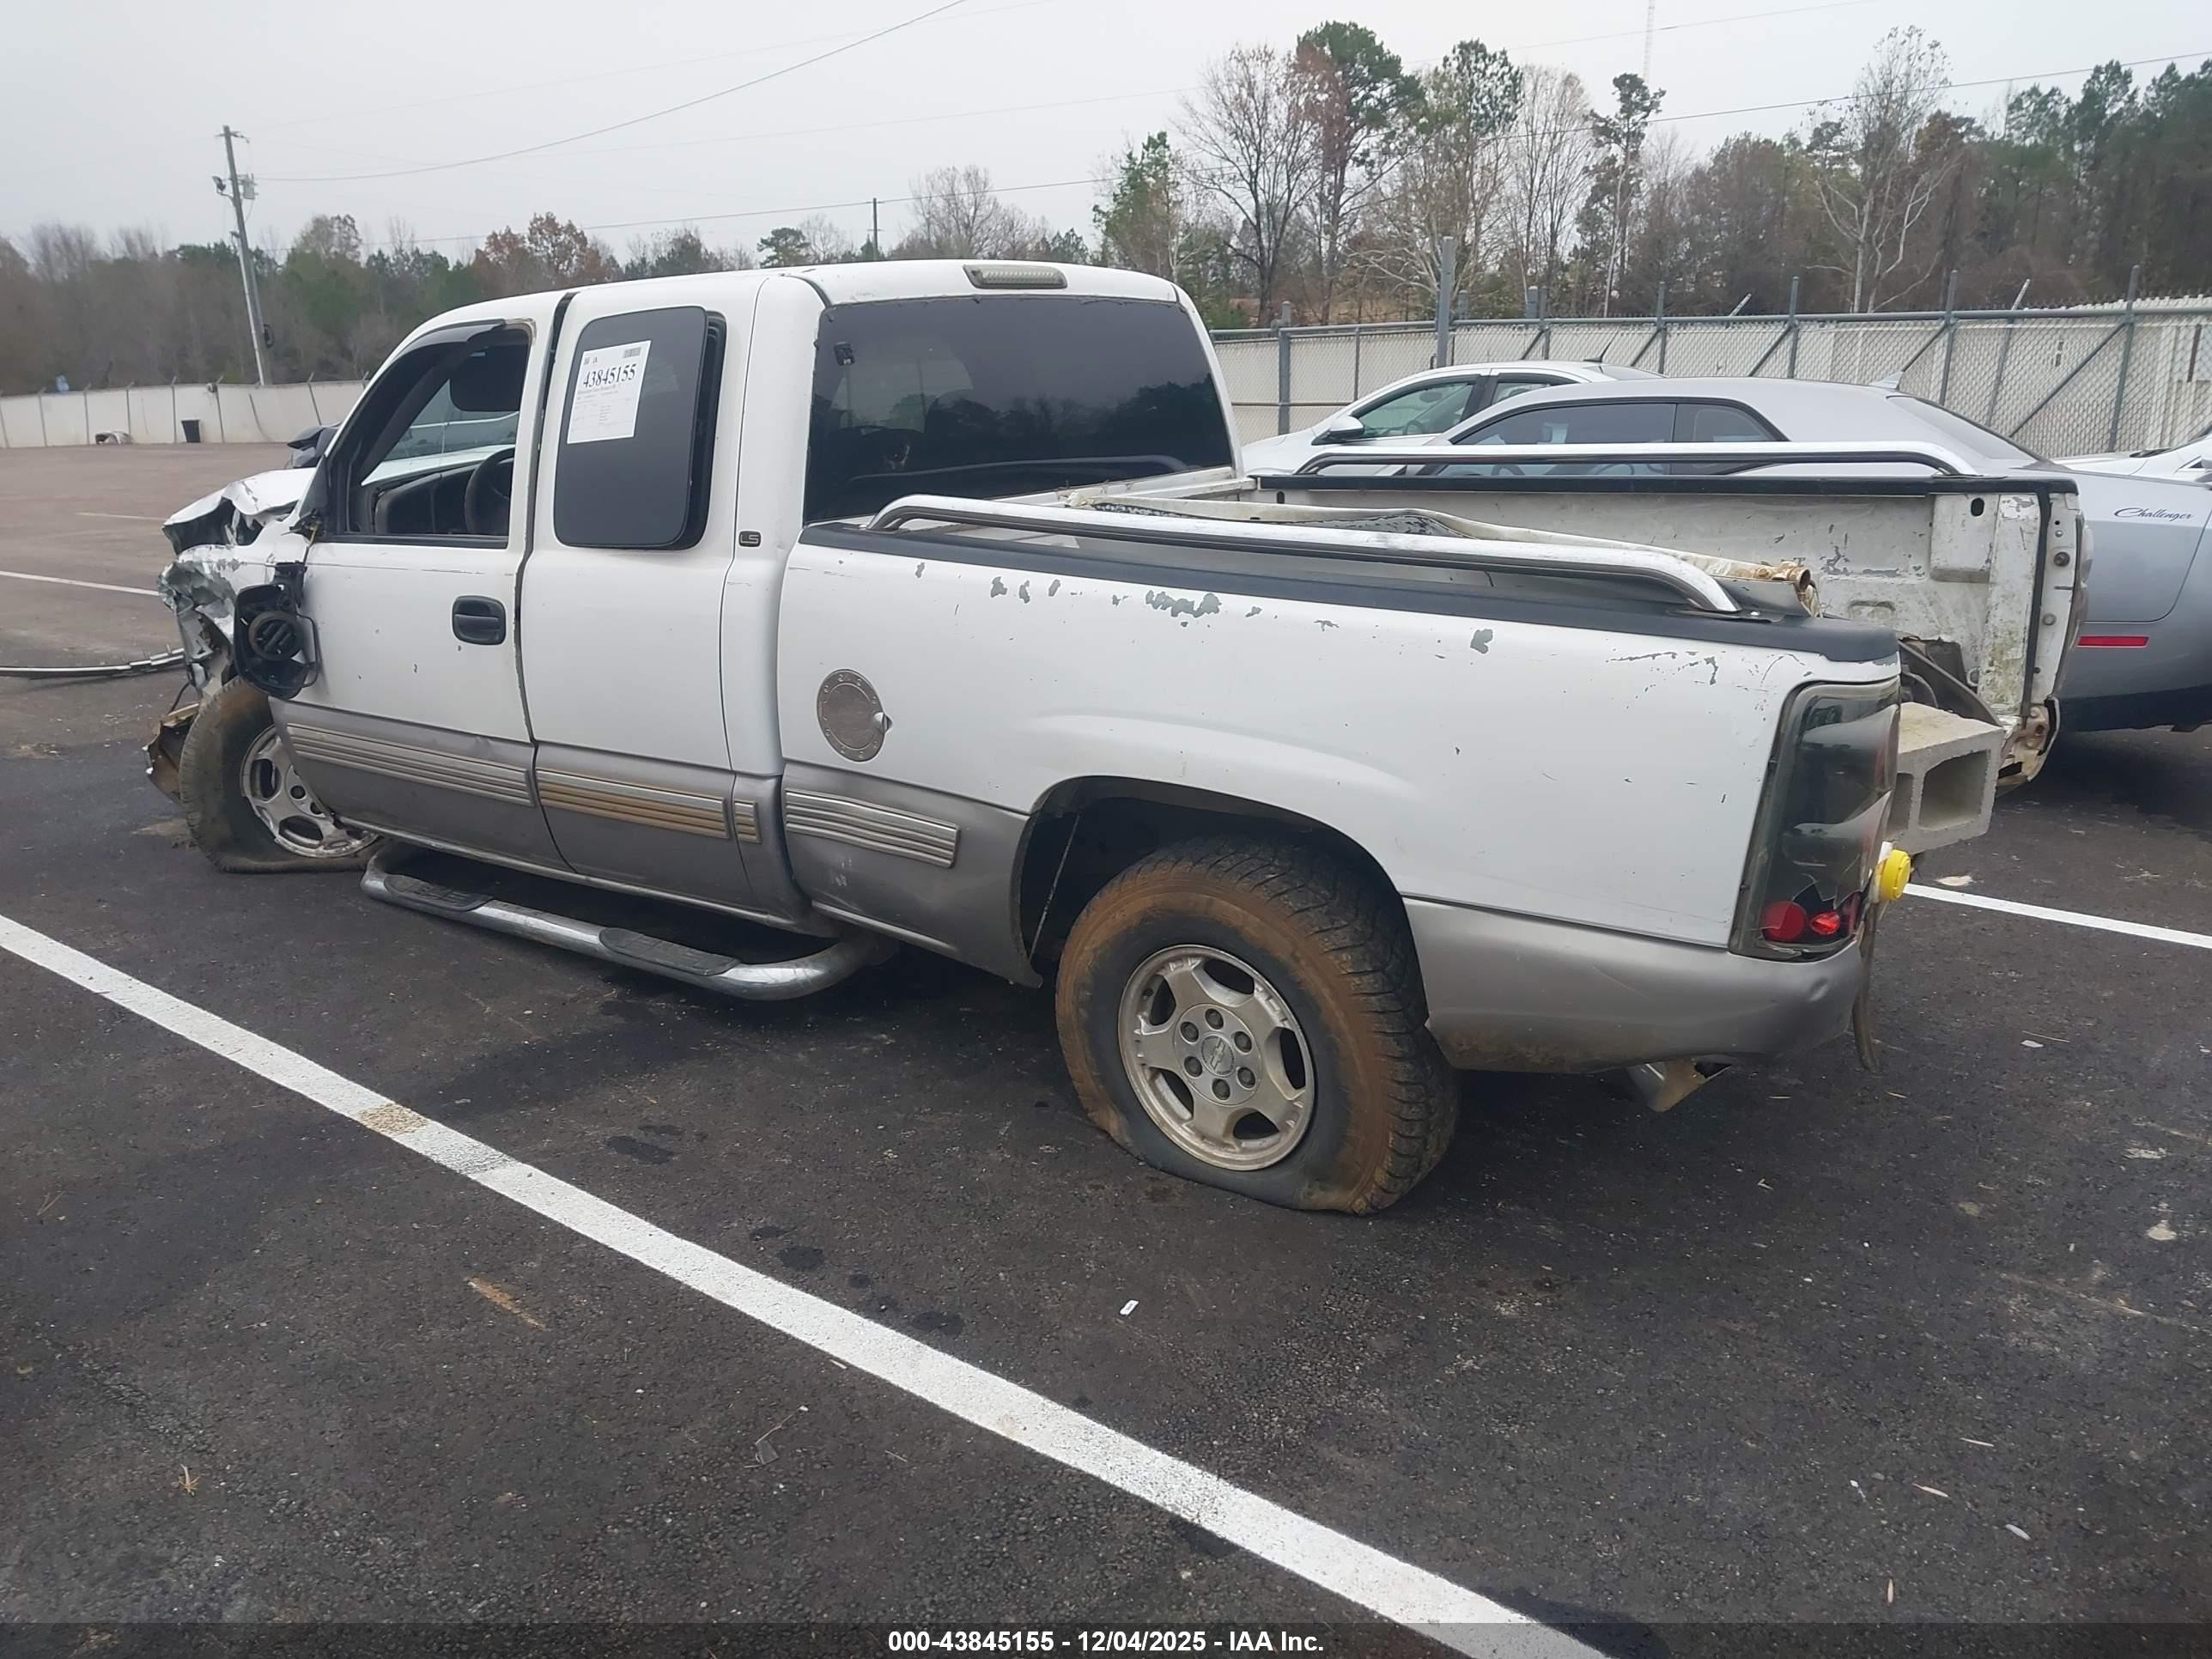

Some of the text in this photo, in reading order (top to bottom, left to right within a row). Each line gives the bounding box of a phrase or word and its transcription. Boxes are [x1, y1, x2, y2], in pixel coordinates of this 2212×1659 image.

[583, 363, 637, 387] 43845155
[2113, 507, 2193, 522] Challenger
[739, 533, 760, 544] LS
